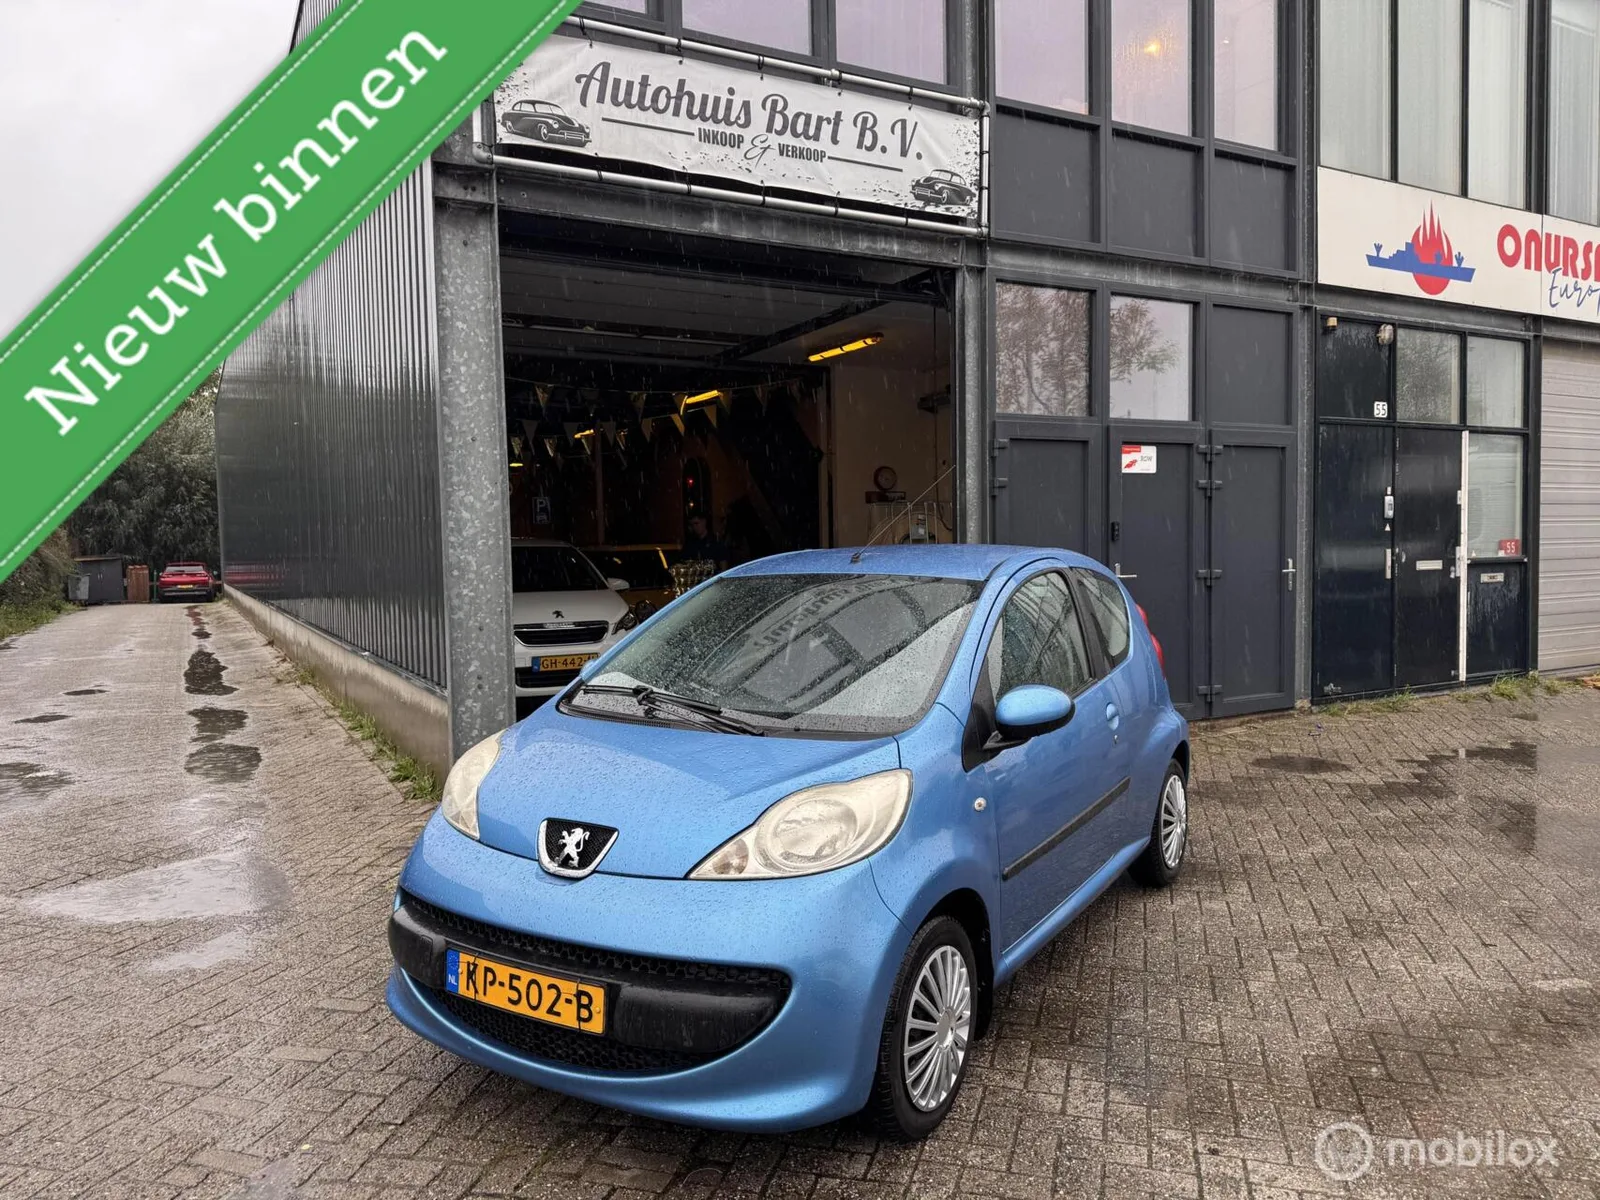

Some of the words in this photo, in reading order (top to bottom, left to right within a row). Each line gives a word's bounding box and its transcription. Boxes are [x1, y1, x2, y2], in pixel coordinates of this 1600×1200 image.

[574, 61, 752, 129] Autohuis
[761, 93, 843, 146] Bart
[853, 110, 923, 160] B.V.
[698, 127, 744, 149] INKOOP
[743, 134, 776, 168] &
[778, 143, 826, 163] VERKOOP
[1375, 403, 1386, 416] 55
[1506, 541, 1516, 553] 55
[448, 974, 458, 986] NL
[466, 960, 593, 1023] KP-502-B
